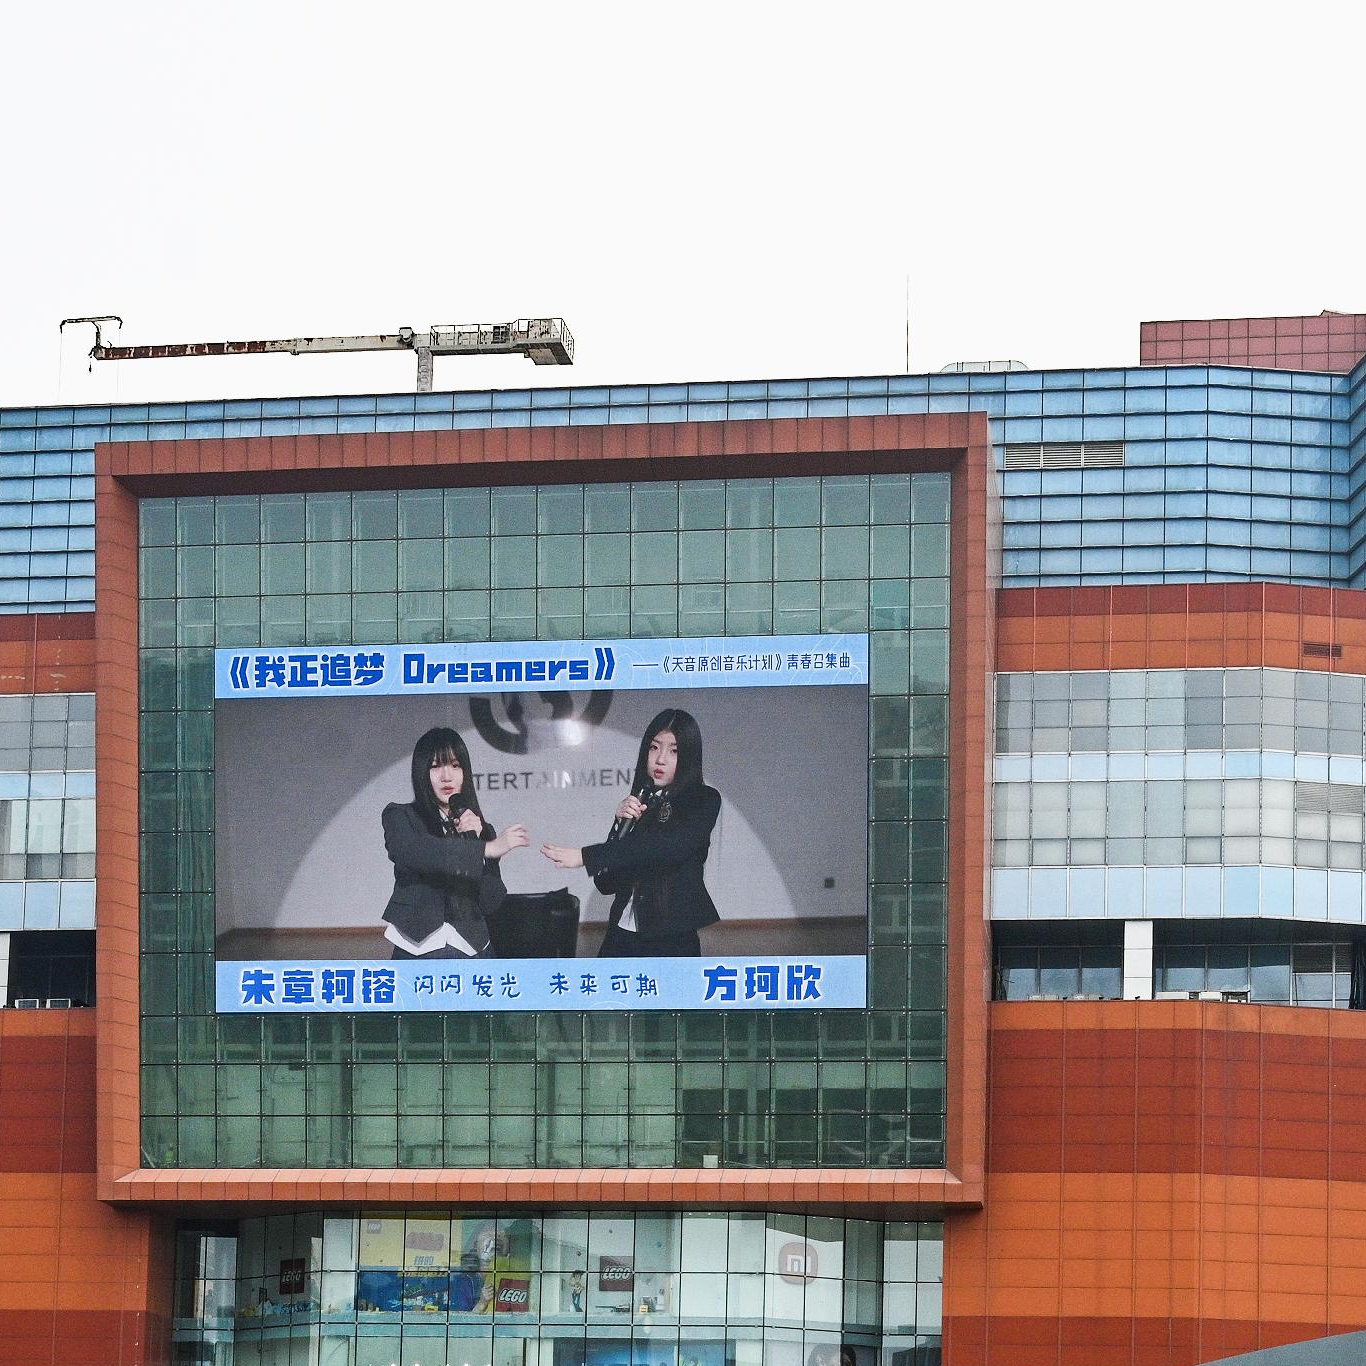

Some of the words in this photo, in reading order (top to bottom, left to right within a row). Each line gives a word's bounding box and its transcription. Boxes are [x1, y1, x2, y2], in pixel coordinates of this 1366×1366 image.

[786, 652, 851, 670] 青春召集曲
[229, 652, 385, 689] 《我正追梦
[240, 968, 397, 1005] 朱章轲镕
[549, 973, 660, 998] 未来可期
[703, 965, 823, 1002] 方珂欣
[602, 1265, 631, 1280] LEGO
[499, 1288, 527, 1304] LEGO
